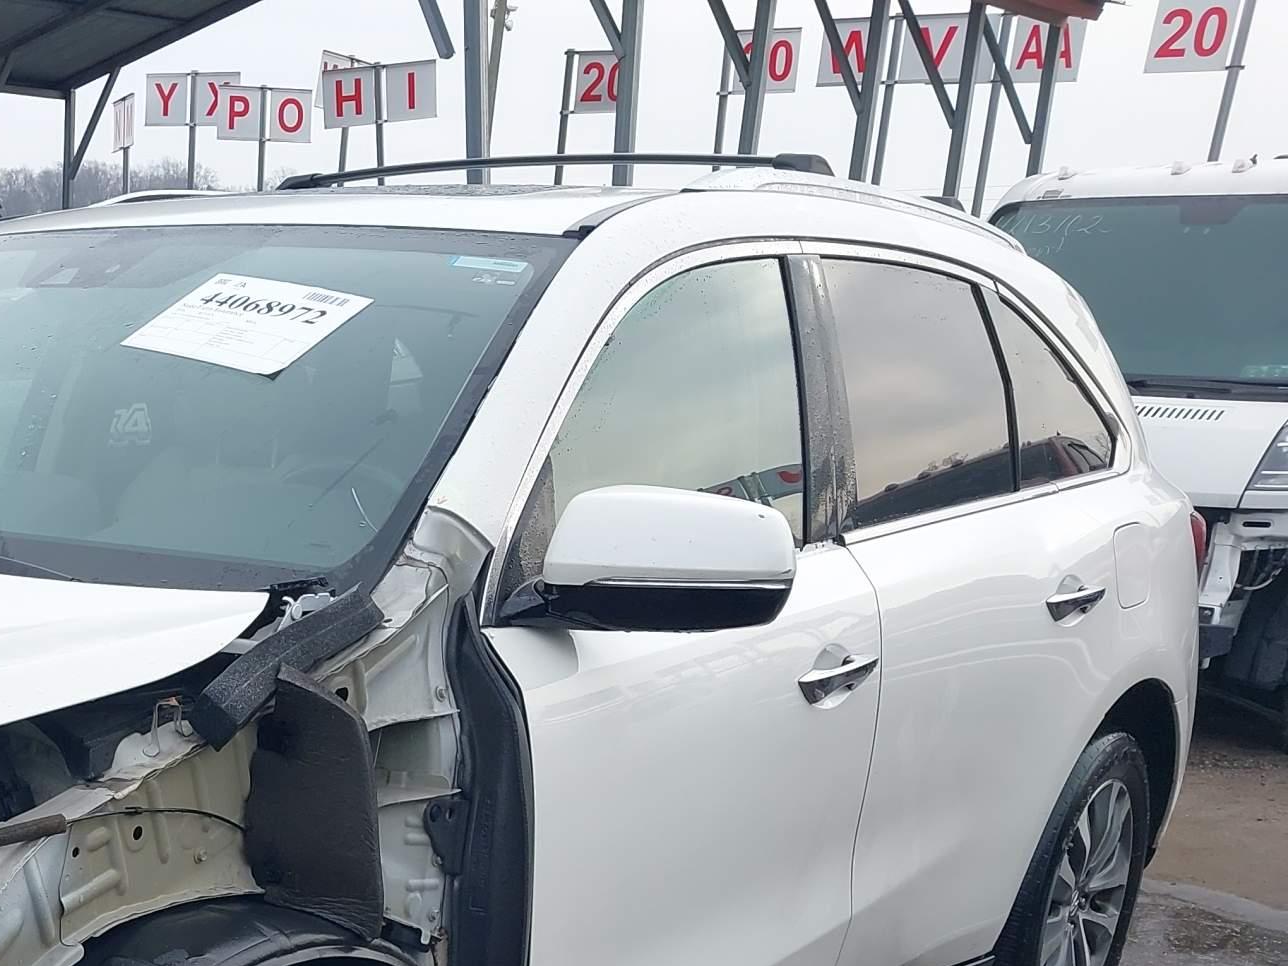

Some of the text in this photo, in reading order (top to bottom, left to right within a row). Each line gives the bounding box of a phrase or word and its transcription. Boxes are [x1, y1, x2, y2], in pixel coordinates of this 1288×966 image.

[1154, 6, 1228, 58] 20
[155, 82, 178, 117] Y
[228, 95, 250, 130] P
[335, 72, 416, 118] H I
[200, 291, 328, 325] 44068972
